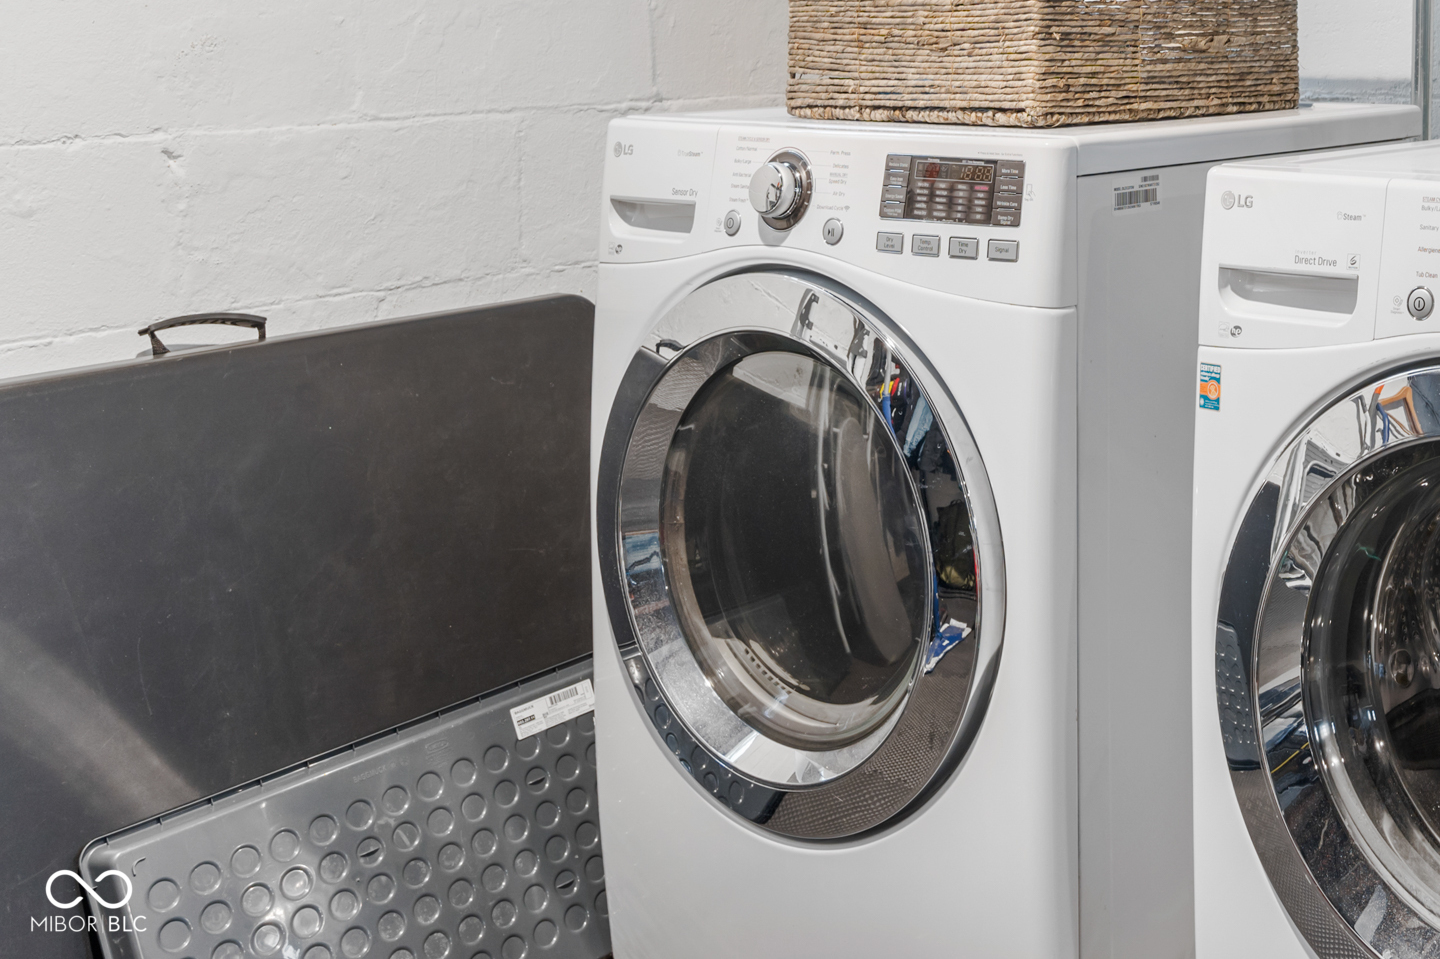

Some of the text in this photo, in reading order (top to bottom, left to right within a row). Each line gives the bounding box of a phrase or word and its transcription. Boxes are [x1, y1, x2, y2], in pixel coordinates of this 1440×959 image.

[623, 144, 633, 155] LG
[671, 188, 698, 198] Sensor Dry
[1237, 194, 1253, 208] LG
[1295, 255, 1337, 267] Direct Drive
